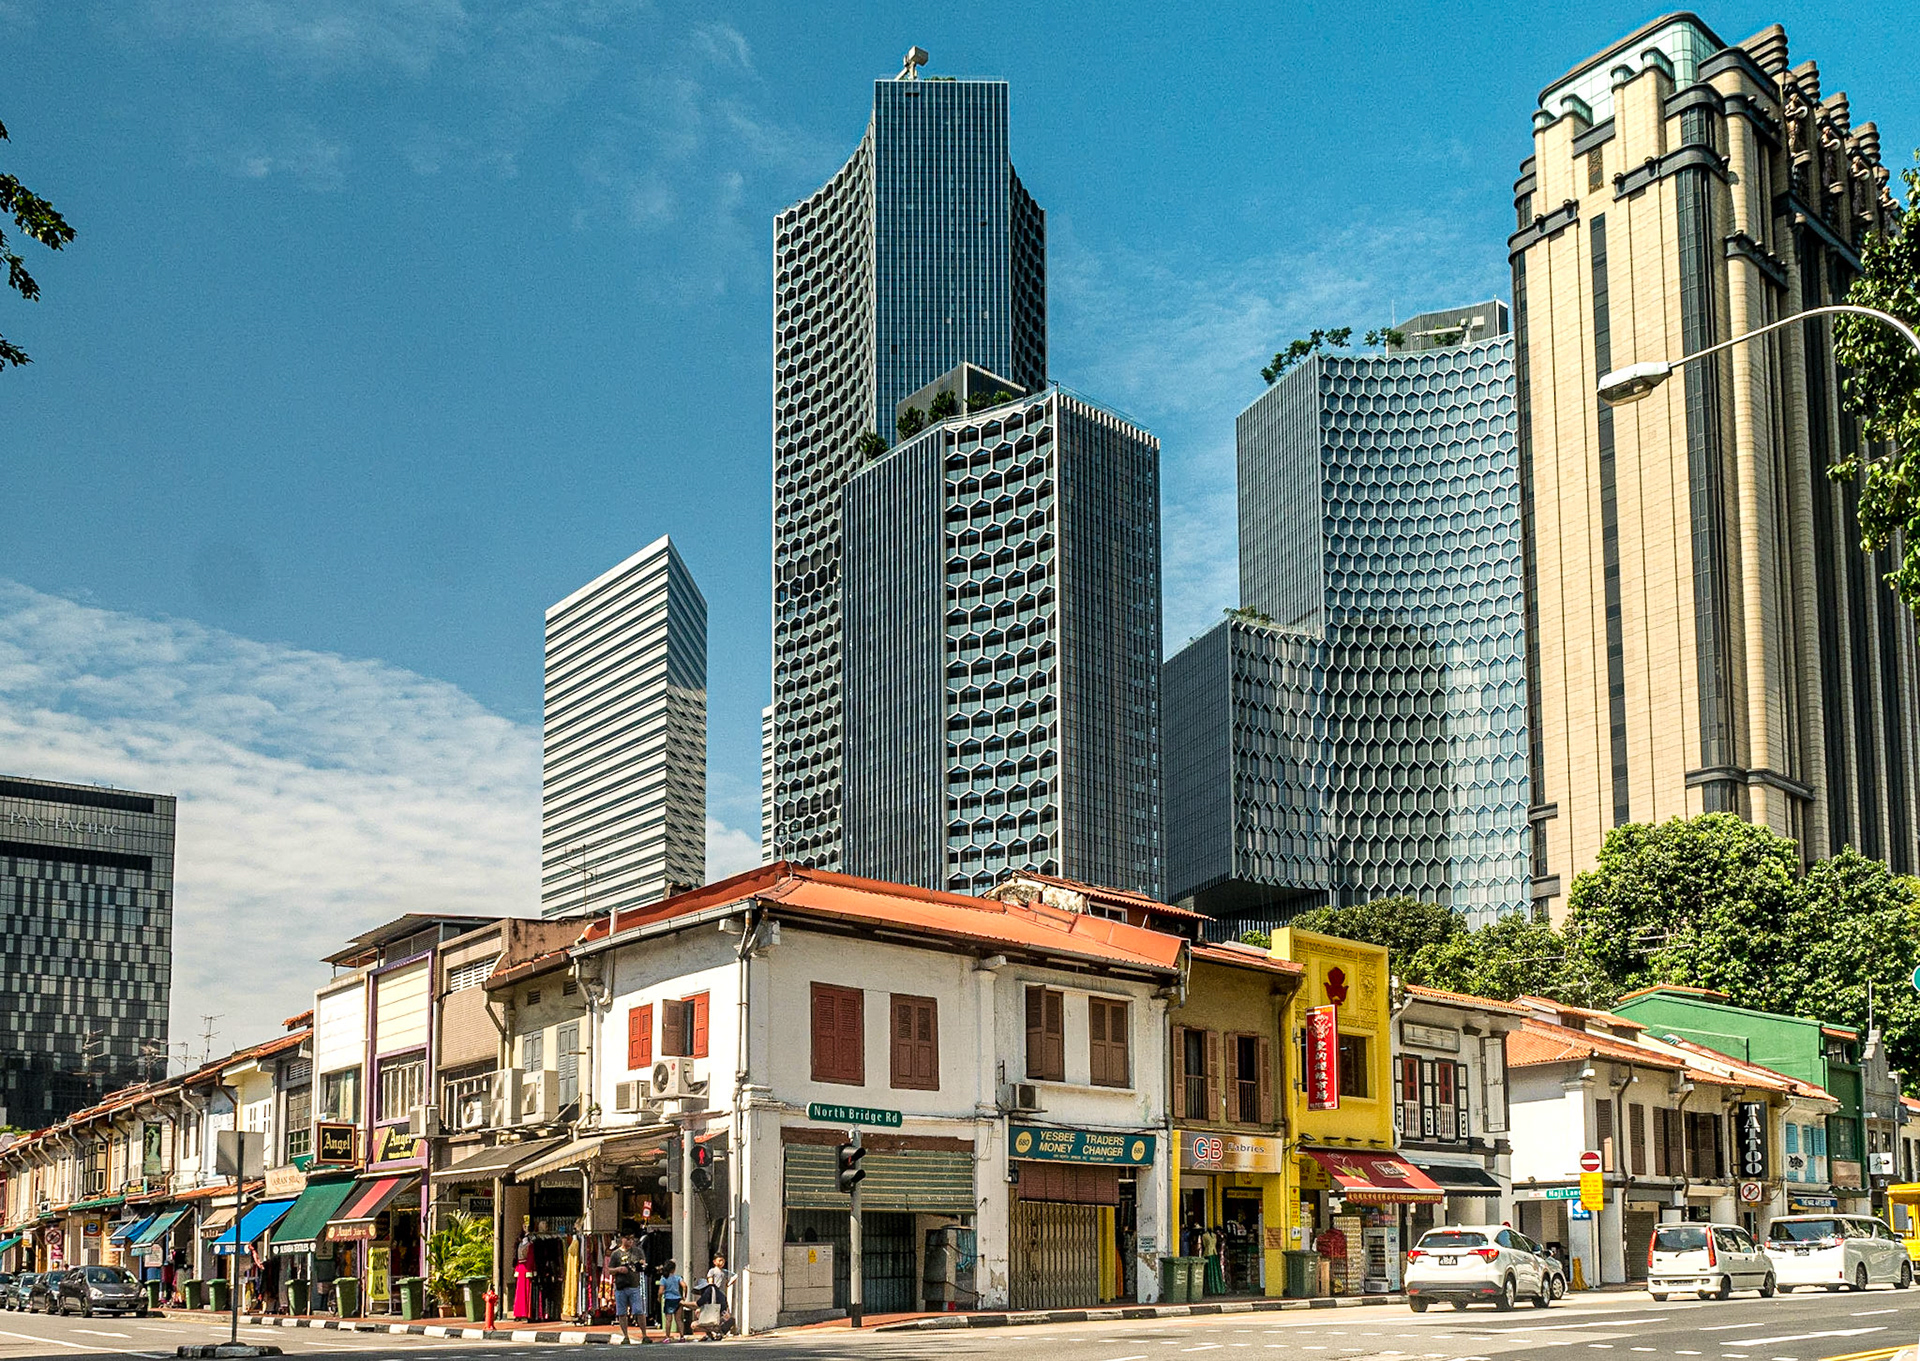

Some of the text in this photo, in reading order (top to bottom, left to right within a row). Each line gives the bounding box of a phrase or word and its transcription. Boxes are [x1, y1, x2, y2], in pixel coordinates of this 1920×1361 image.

[10, 811, 124, 836] PAN PACIFIC
[814, 1105, 898, 1123] North Bridge Rd
[323, 1132, 351, 1154] Angel
[1040, 1131, 1125, 1146] YESBEE TRADERS
[1227, 1142, 1265, 1153] Fabrics
[1744, 1104, 1763, 1174] TATTOO
[1039, 1142, 1124, 1157] MONEY CHANGER
[1193, 1137, 1223, 1161] GB
